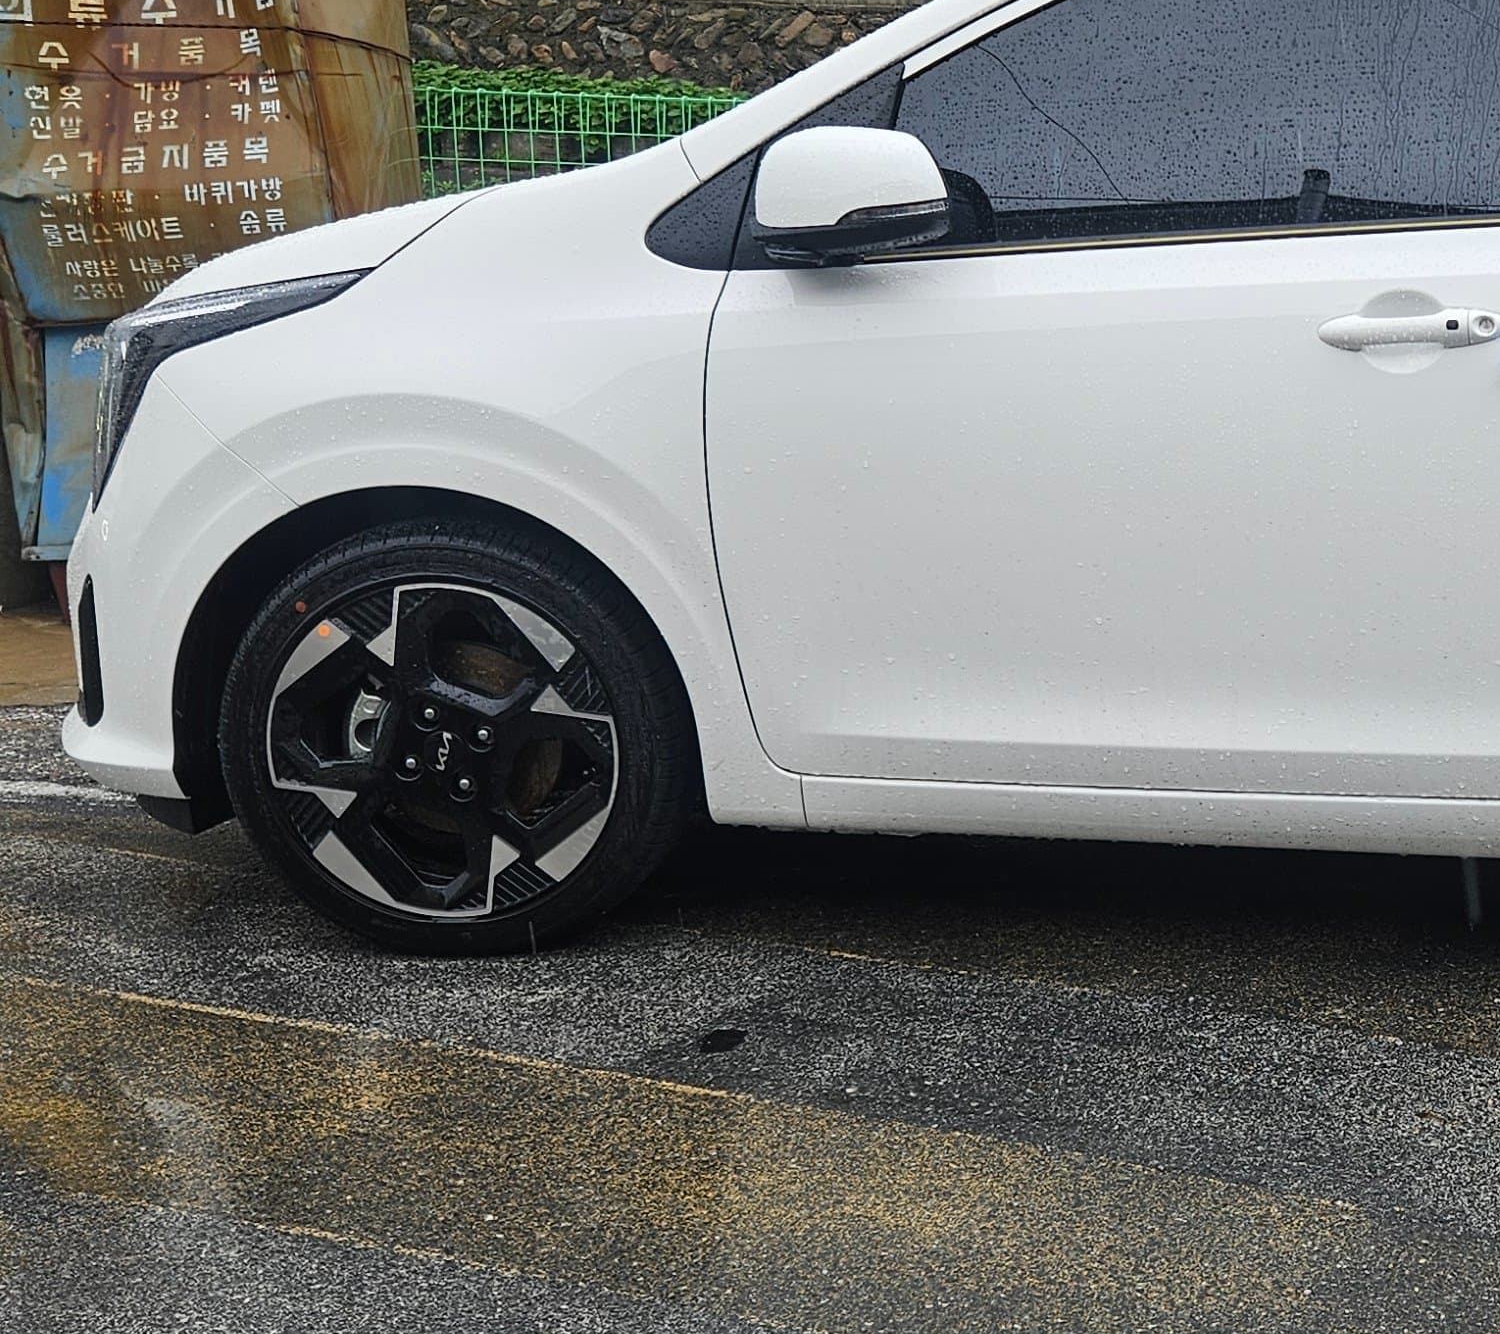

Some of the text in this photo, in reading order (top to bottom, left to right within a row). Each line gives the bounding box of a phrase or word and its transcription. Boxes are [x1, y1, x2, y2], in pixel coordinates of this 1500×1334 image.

[24, 85, 83, 110] 헌옷
[134, 80, 181, 104] 가방
[29, 99, 281, 141] 신발 담요 카펫
[42, 136, 270, 178] 수거금지품목
[184, 176, 283, 206] 바퀴가방
[239, 208, 287, 235] 솜류
[65, 259, 119, 279] 사랑은
